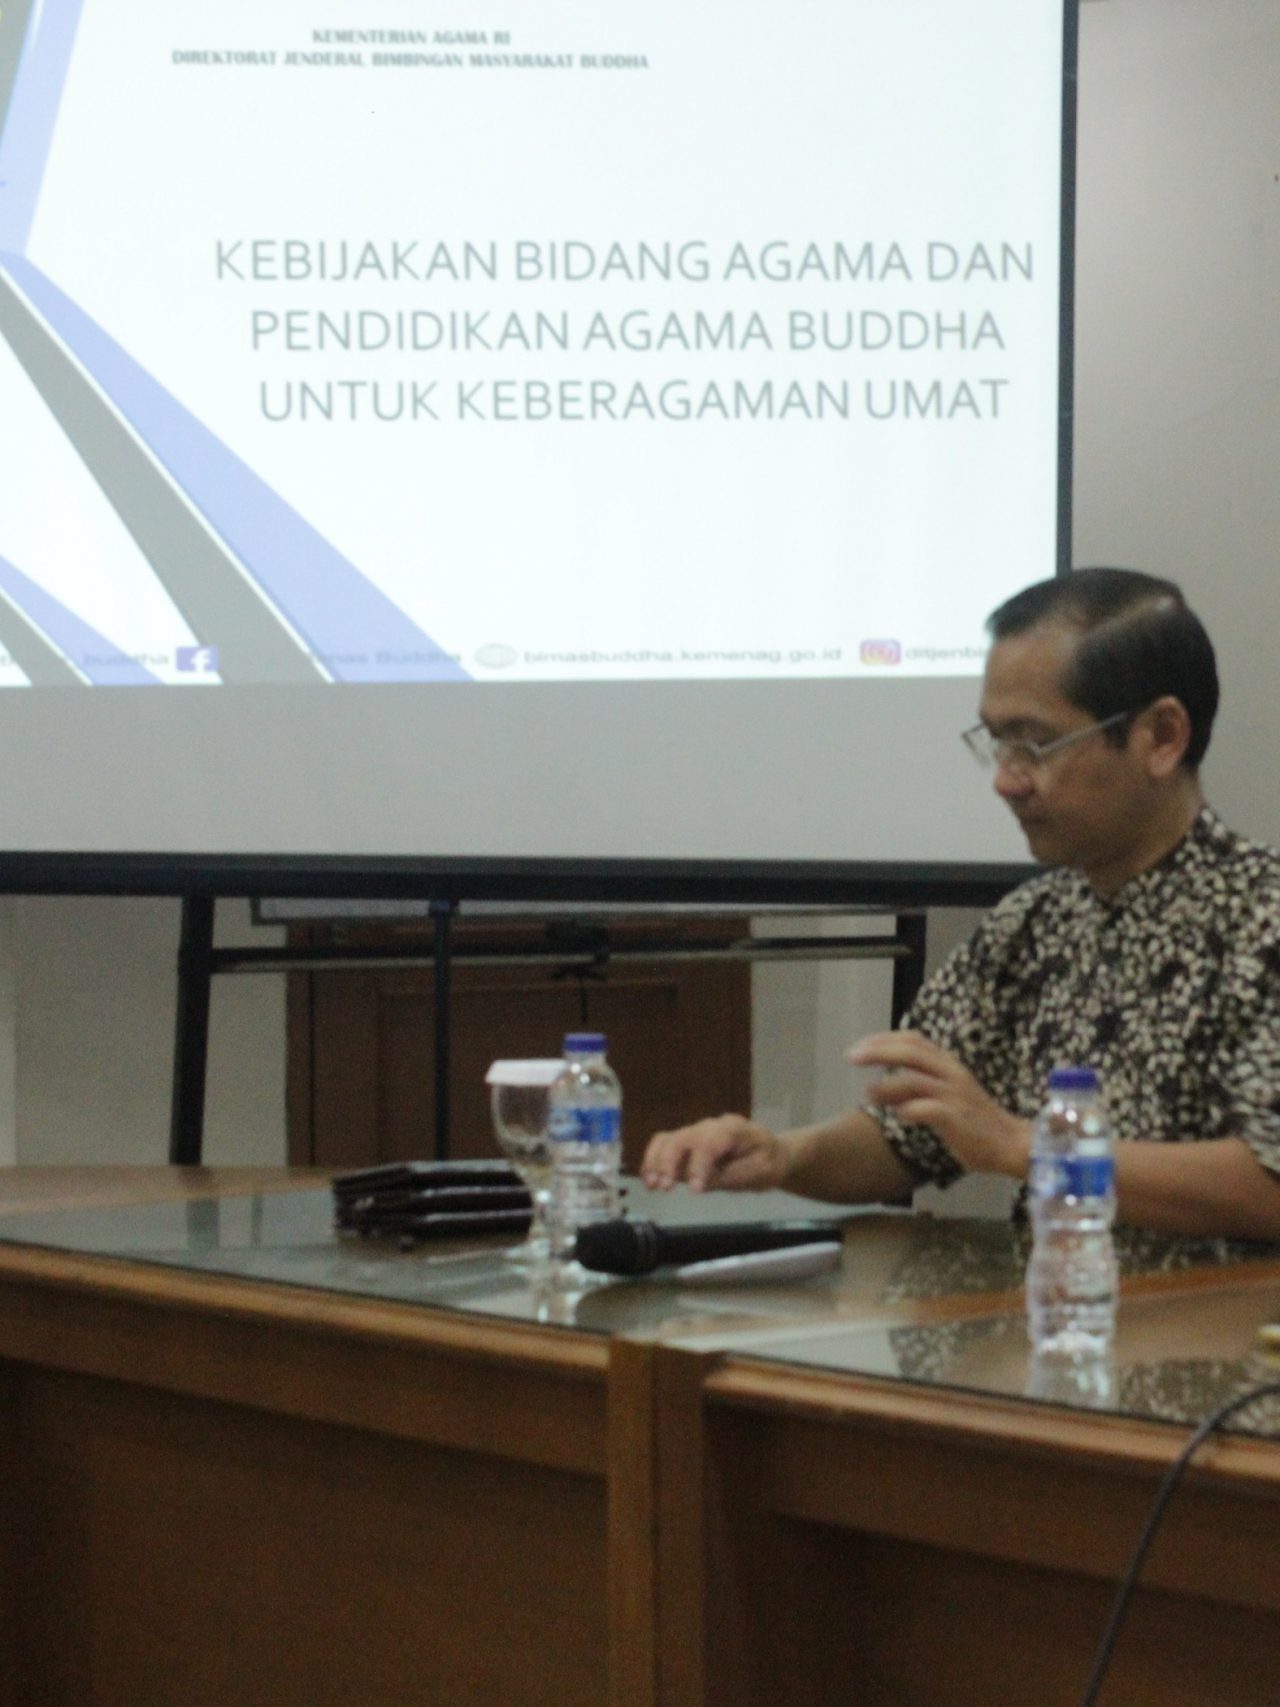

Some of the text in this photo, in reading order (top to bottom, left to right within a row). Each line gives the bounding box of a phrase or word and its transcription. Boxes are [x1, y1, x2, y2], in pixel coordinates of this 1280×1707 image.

[312, 29, 511, 46] KEMENTERIAN AGAMA RI
[171, 50, 650, 69] DIREKTORAT JENDERAL BIMBINGAN MASYARAKAT BUDDHA
[215, 240, 1034, 282] KEBIJAKAN BIDANG AGAMA DAN
[252, 310, 1005, 352] PENDIDIKAN AGAMA BUDDHA
[260, 380, 1010, 422] UNTUK KEBERAGAMAN UMAT
